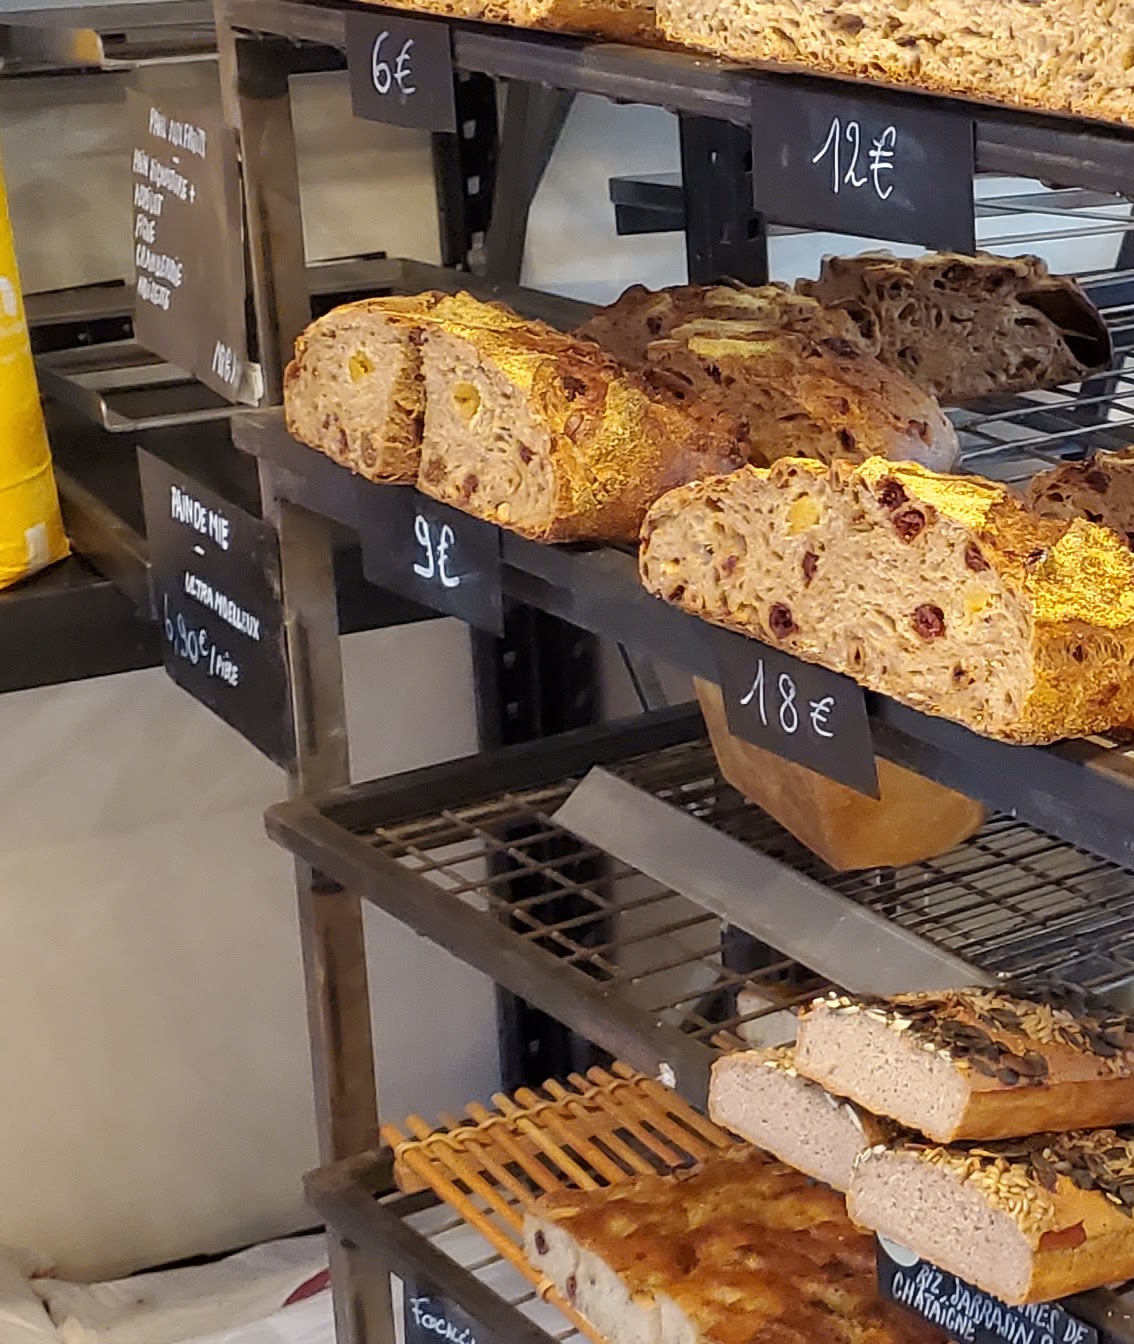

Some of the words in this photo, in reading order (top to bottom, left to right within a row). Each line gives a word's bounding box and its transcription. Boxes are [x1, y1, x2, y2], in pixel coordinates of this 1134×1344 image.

[371, 30, 418, 97] 6€
[812, 116, 897, 200] 12€
[412, 514, 461, 588] 9€
[740, 659, 835, 738] 18€
